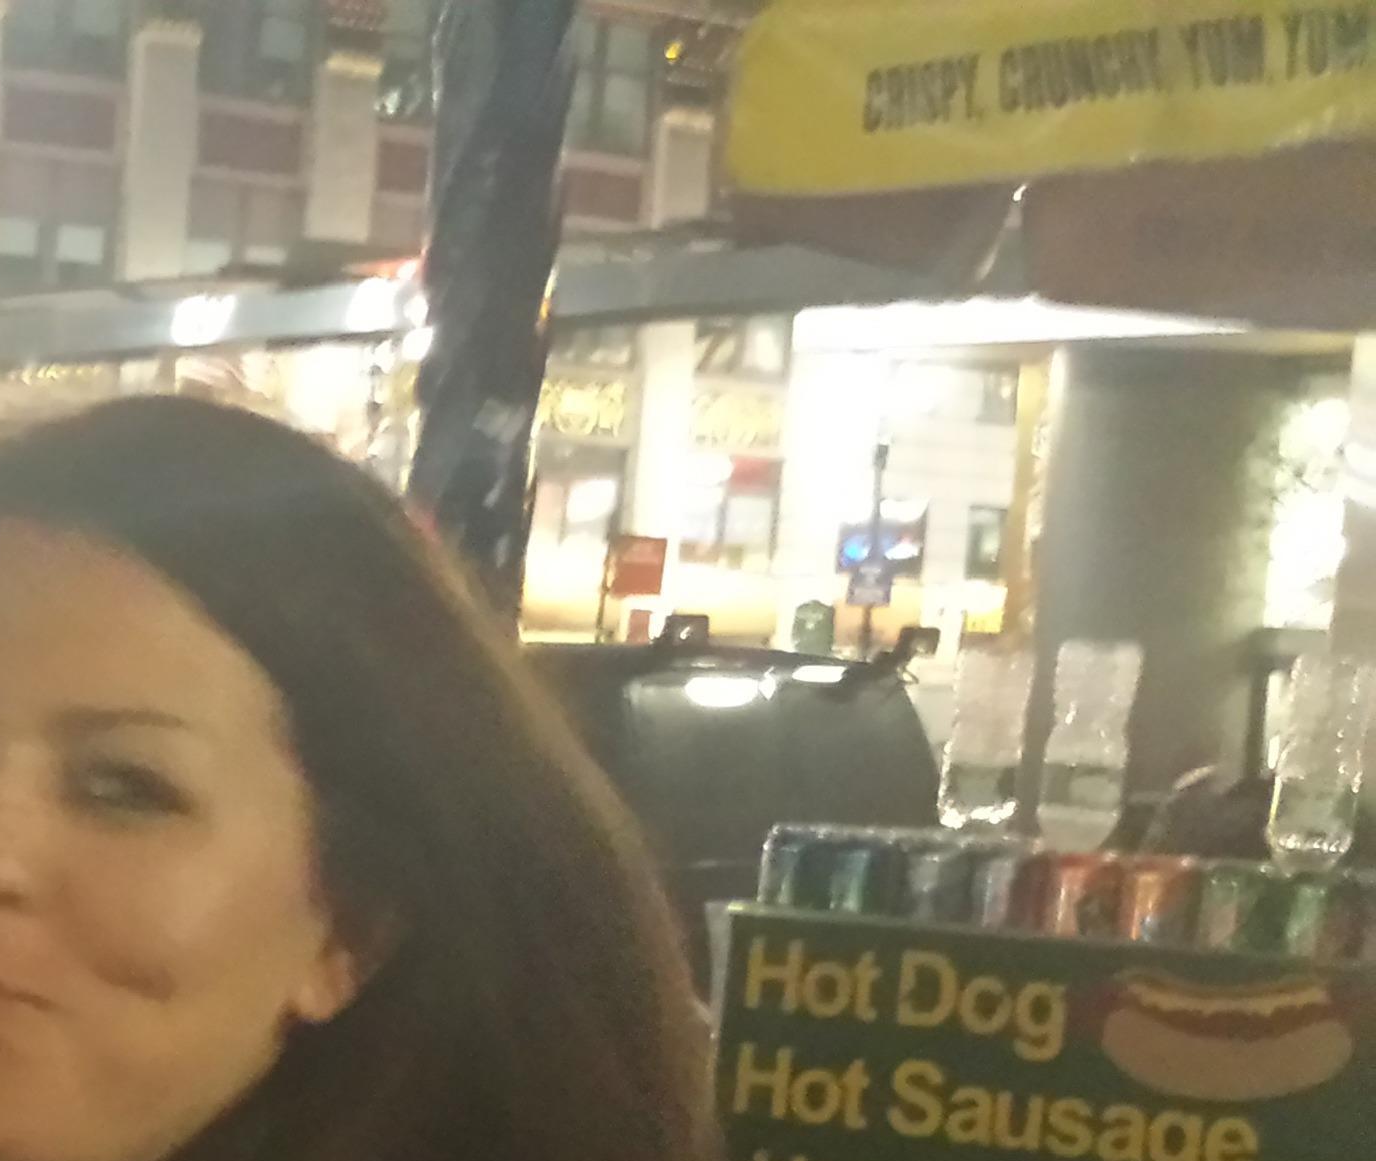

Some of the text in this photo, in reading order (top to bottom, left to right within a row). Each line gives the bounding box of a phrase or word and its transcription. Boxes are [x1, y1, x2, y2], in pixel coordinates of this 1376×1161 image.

[743, 935, 1068, 1063] Hot Dog
[732, 1041, 871, 1131] Hot
